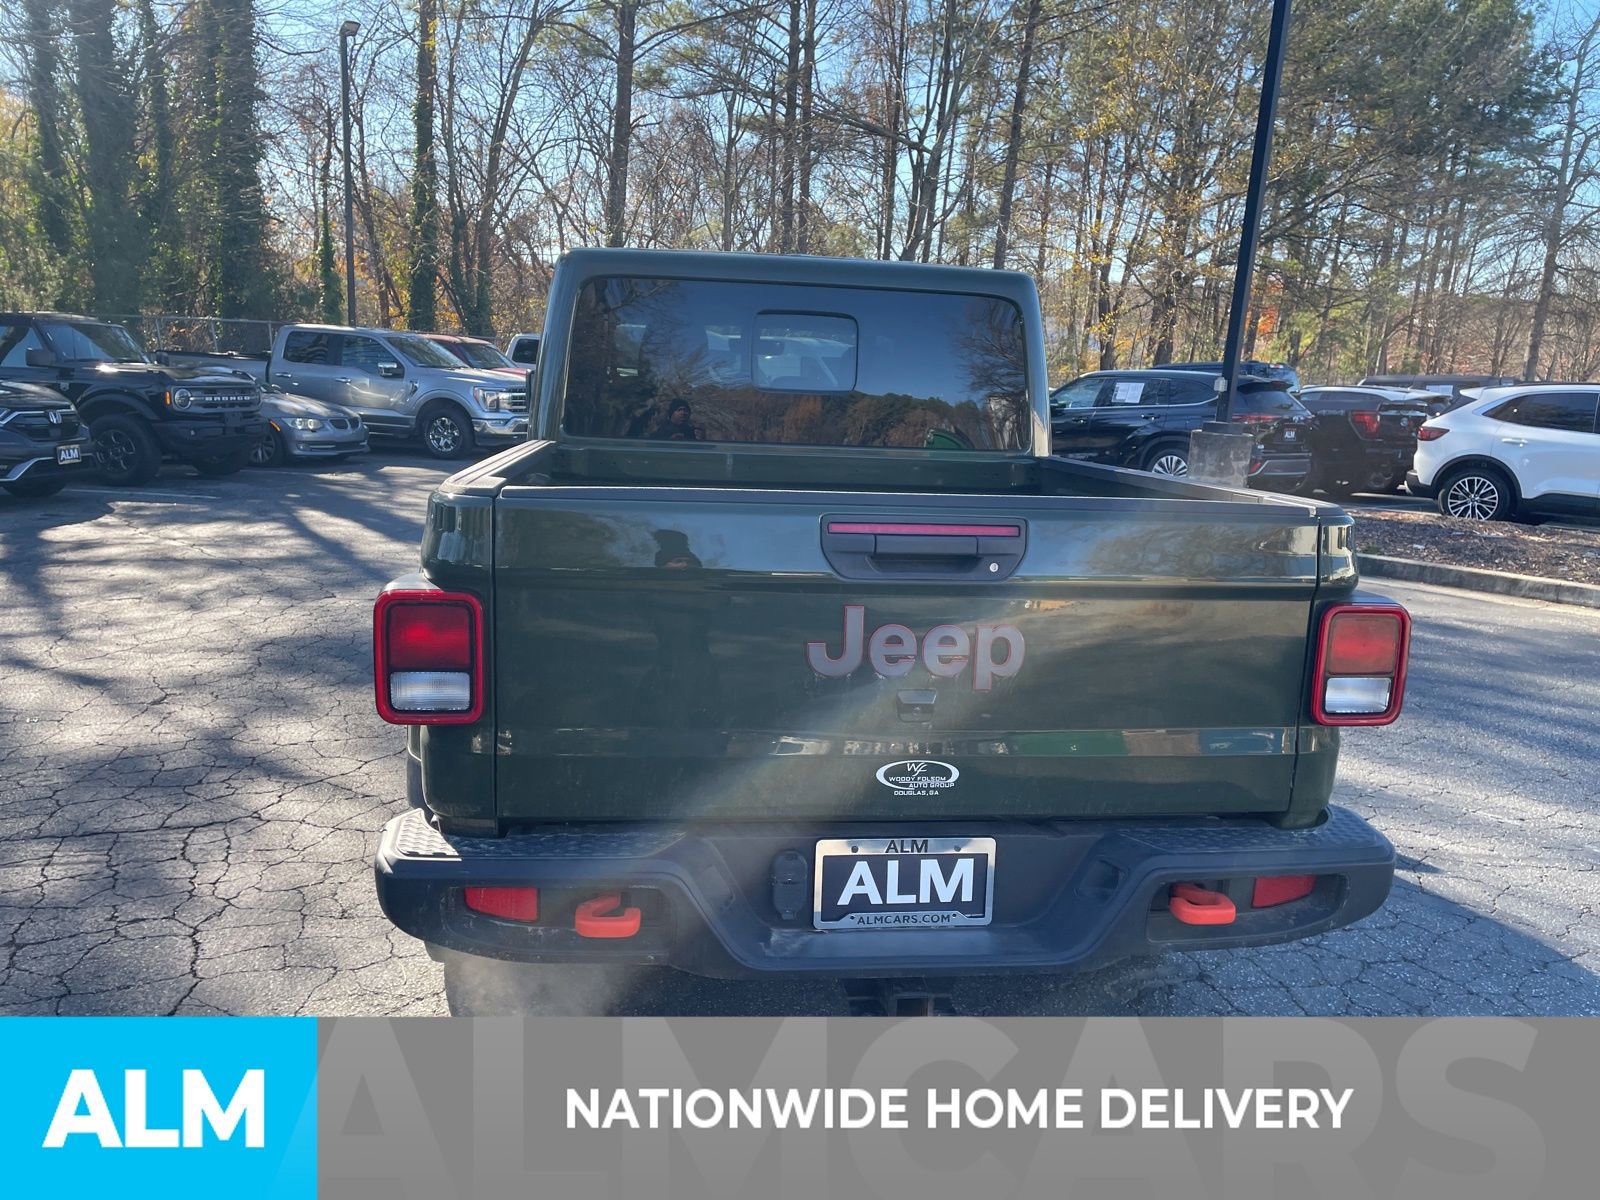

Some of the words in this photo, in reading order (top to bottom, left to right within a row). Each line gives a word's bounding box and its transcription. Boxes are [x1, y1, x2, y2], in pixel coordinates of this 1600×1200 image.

[60, 448, 79, 460] ALM
[807, 605, 1025, 691] Jeep
[885, 839, 928, 853] ALM
[837, 858, 975, 906] ALM
[857, 915, 950, 925] ALMCARS.COM
